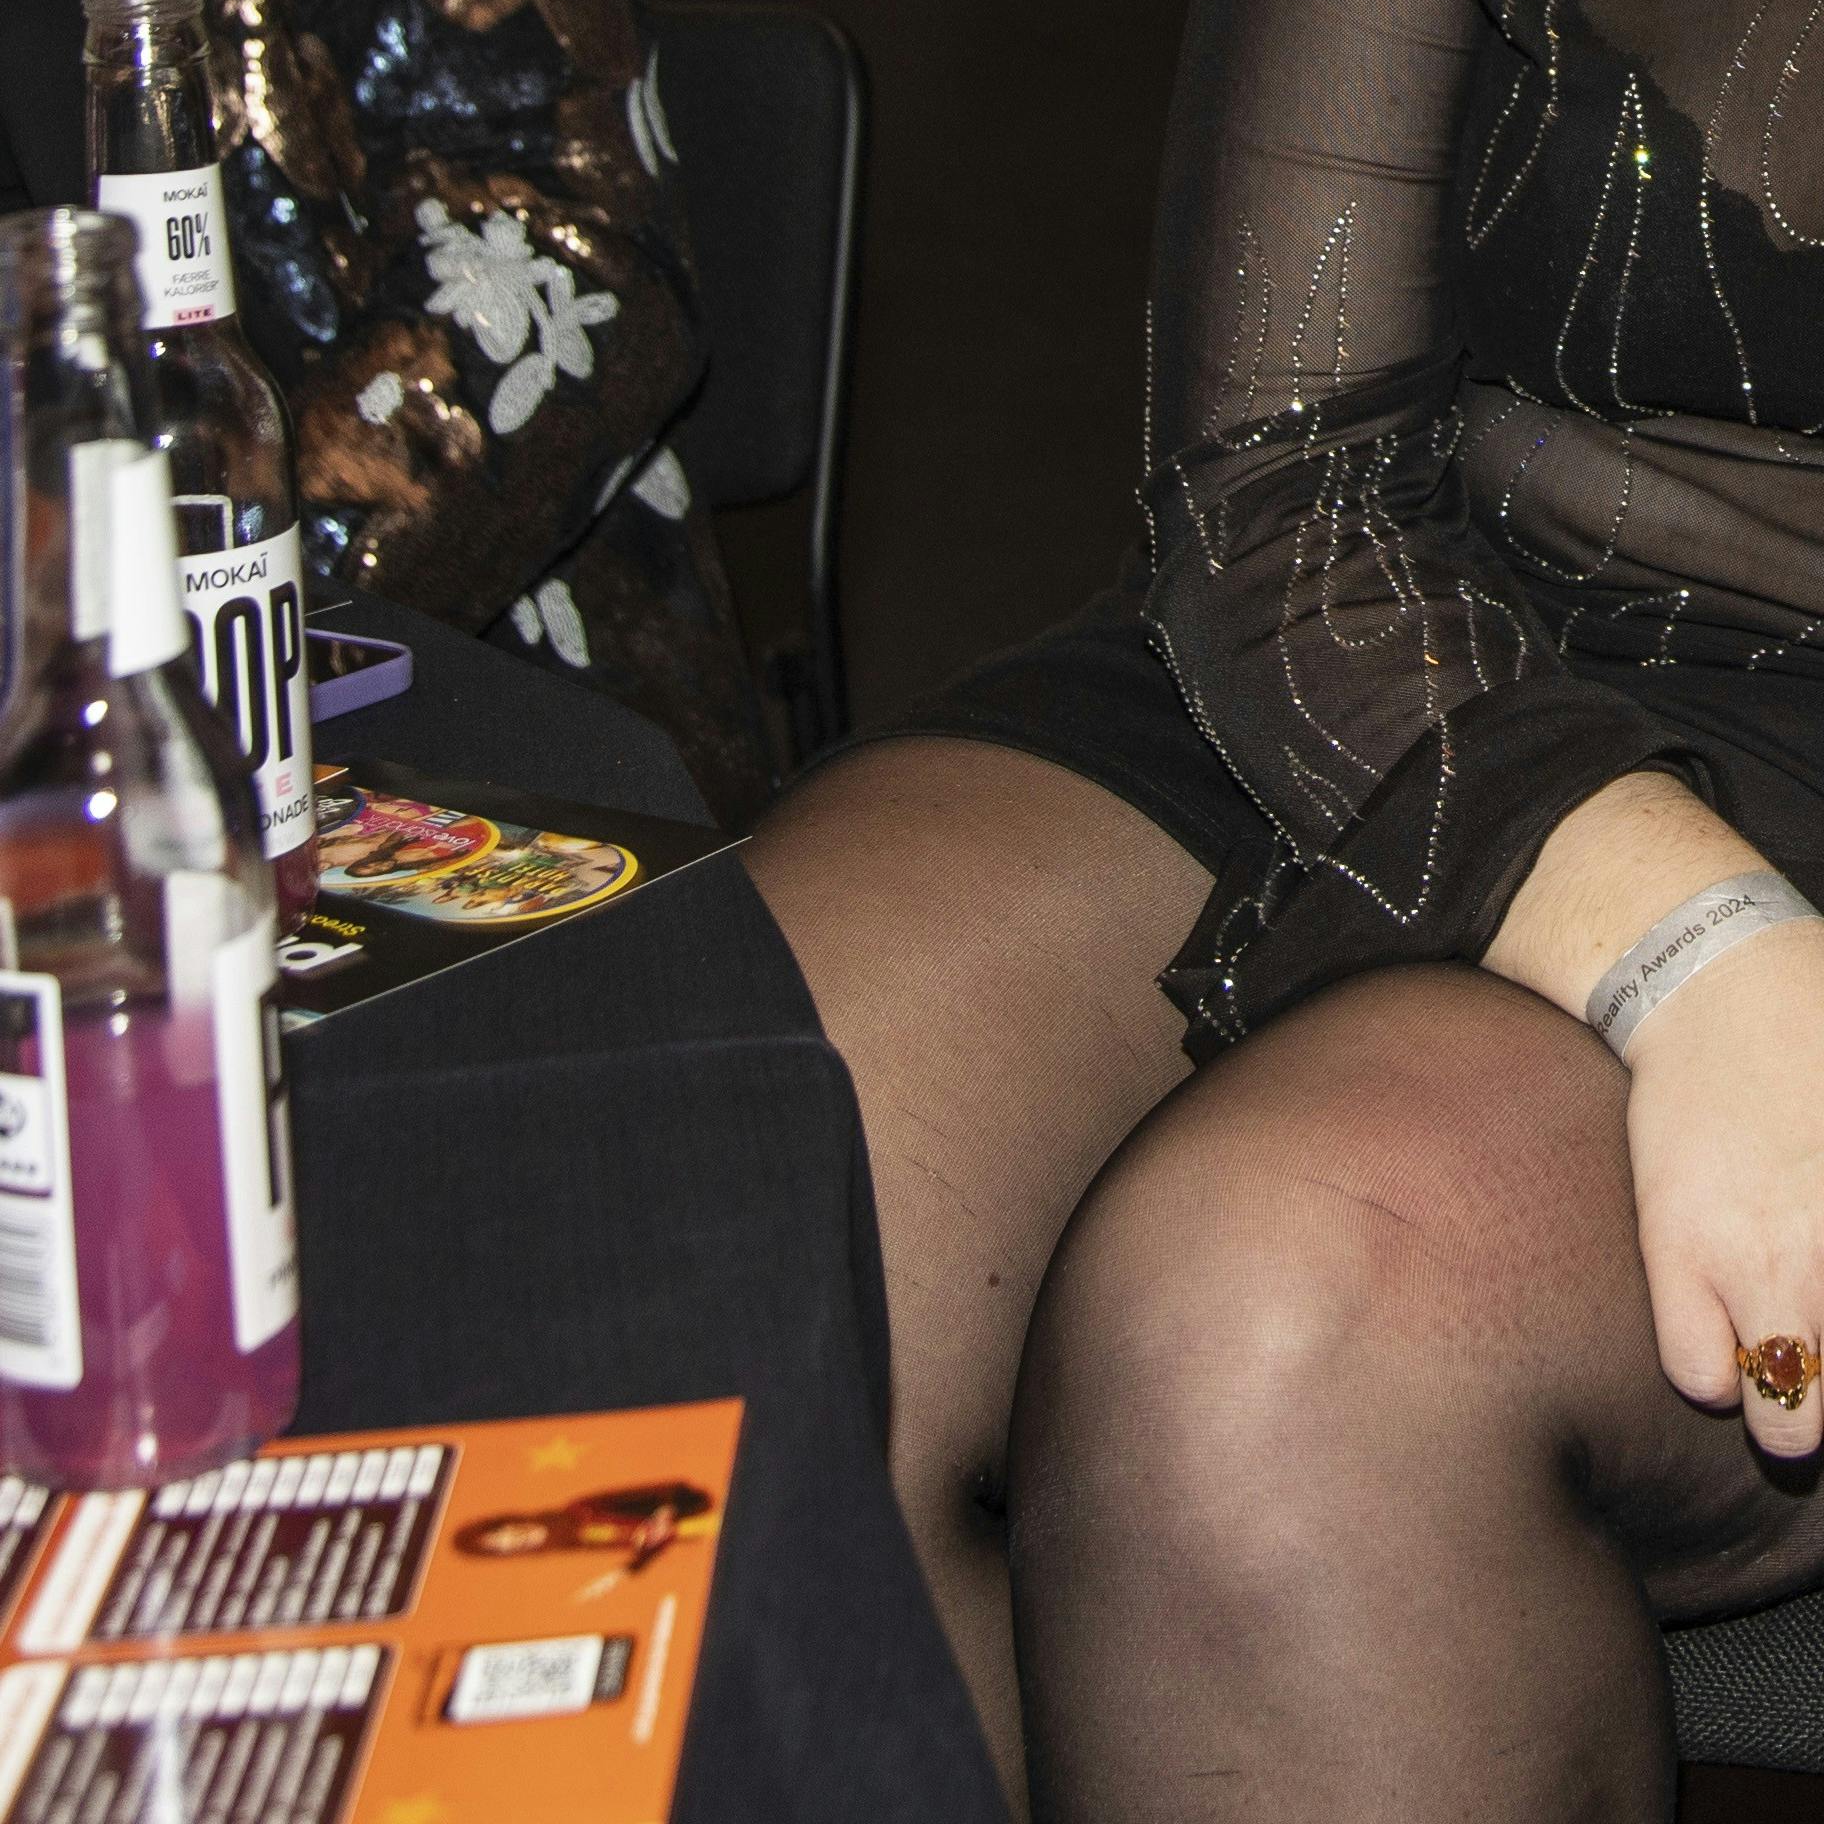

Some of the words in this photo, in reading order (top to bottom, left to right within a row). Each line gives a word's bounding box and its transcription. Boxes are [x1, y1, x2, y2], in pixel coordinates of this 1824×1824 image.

[166, 211, 211, 261] 60%
[177, 308, 212, 321] LITE
[1640, 923, 1706, 982] Awards
[1705, 893, 1756, 927] 2024
